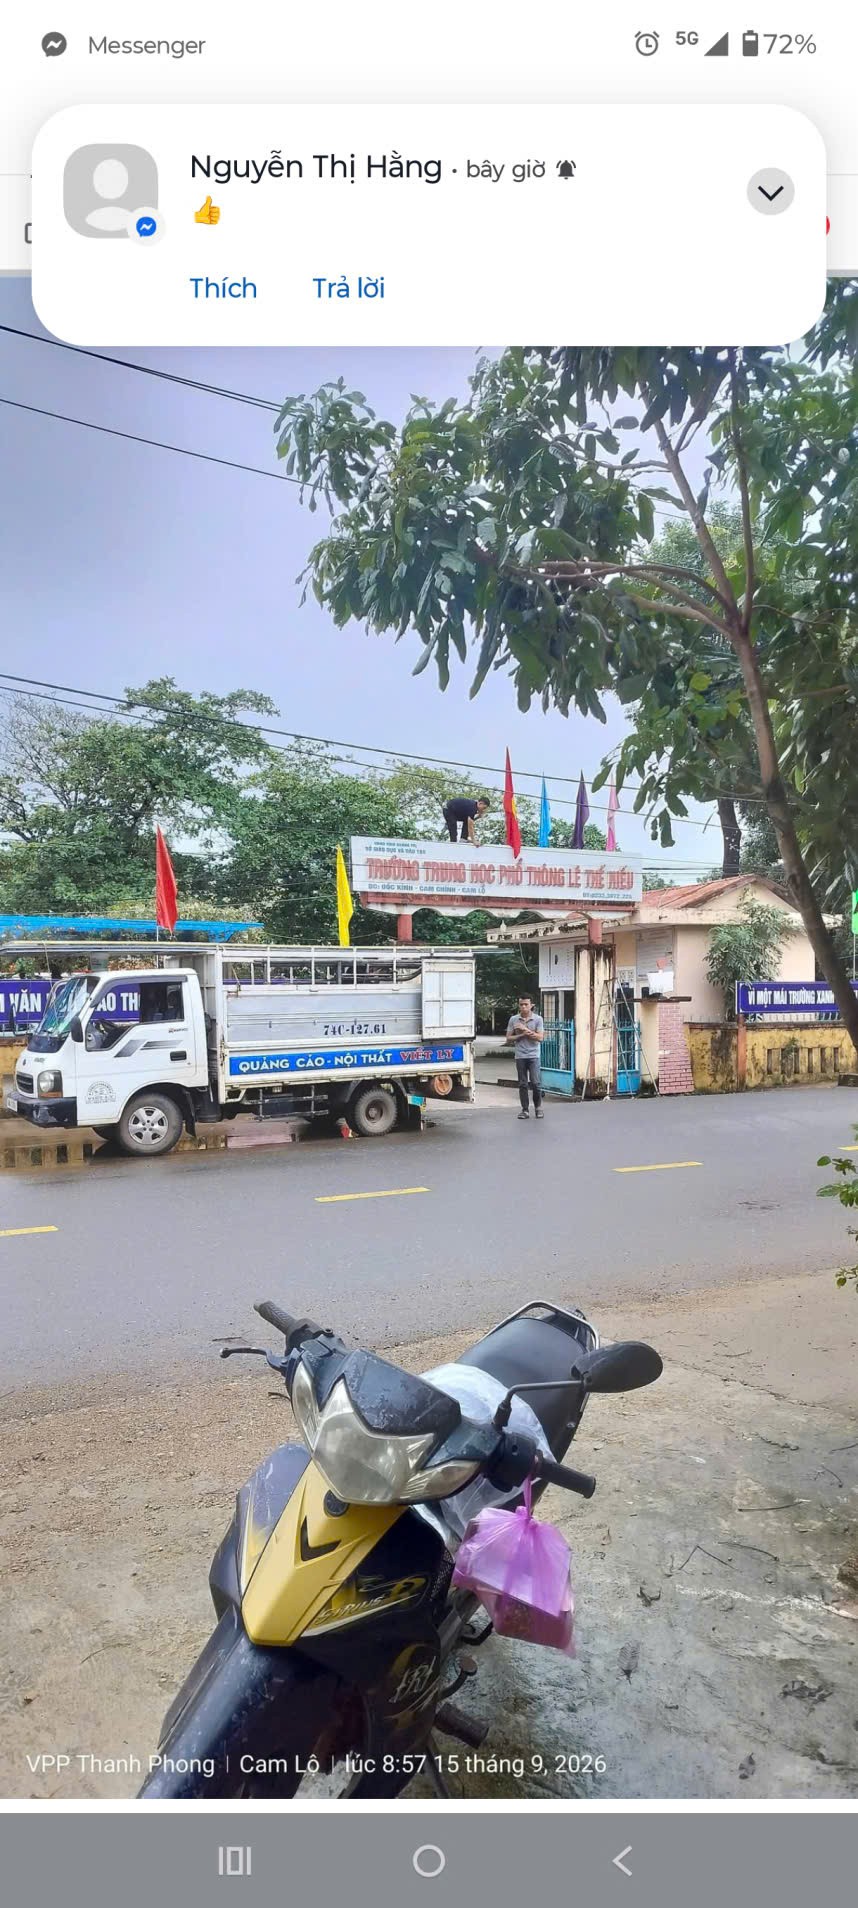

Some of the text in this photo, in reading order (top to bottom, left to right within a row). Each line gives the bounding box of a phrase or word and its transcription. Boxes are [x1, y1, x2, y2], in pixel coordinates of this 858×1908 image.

[367, 855, 420, 881] TRƯỜNG
[423, 860, 467, 883] TRUNG
[469, 864, 496, 887] HỌC
[499, 858, 524, 885] PHỔ
[526, 863, 565, 887] THÔNG
[585, 864, 605, 889] THẾ
[9, 989, 42, 1013] VĂN
[120, 992, 141, 1012] TH
[748, 987, 756, 1005] VÌ
[756, 987, 772, 1008] MỘT
[773, 987, 787, 1005] MÁI
[789, 986, 816, 1005] TRƯỜNG
[324, 1024, 387, 1035] 74C-127.61
[238, 1056, 290, 1073] QUẢNG
[295, 1053, 325, 1068] CÁO
[334, 1051, 358, 1067] NỘI
[360, 1049, 393, 1064] THẤT
